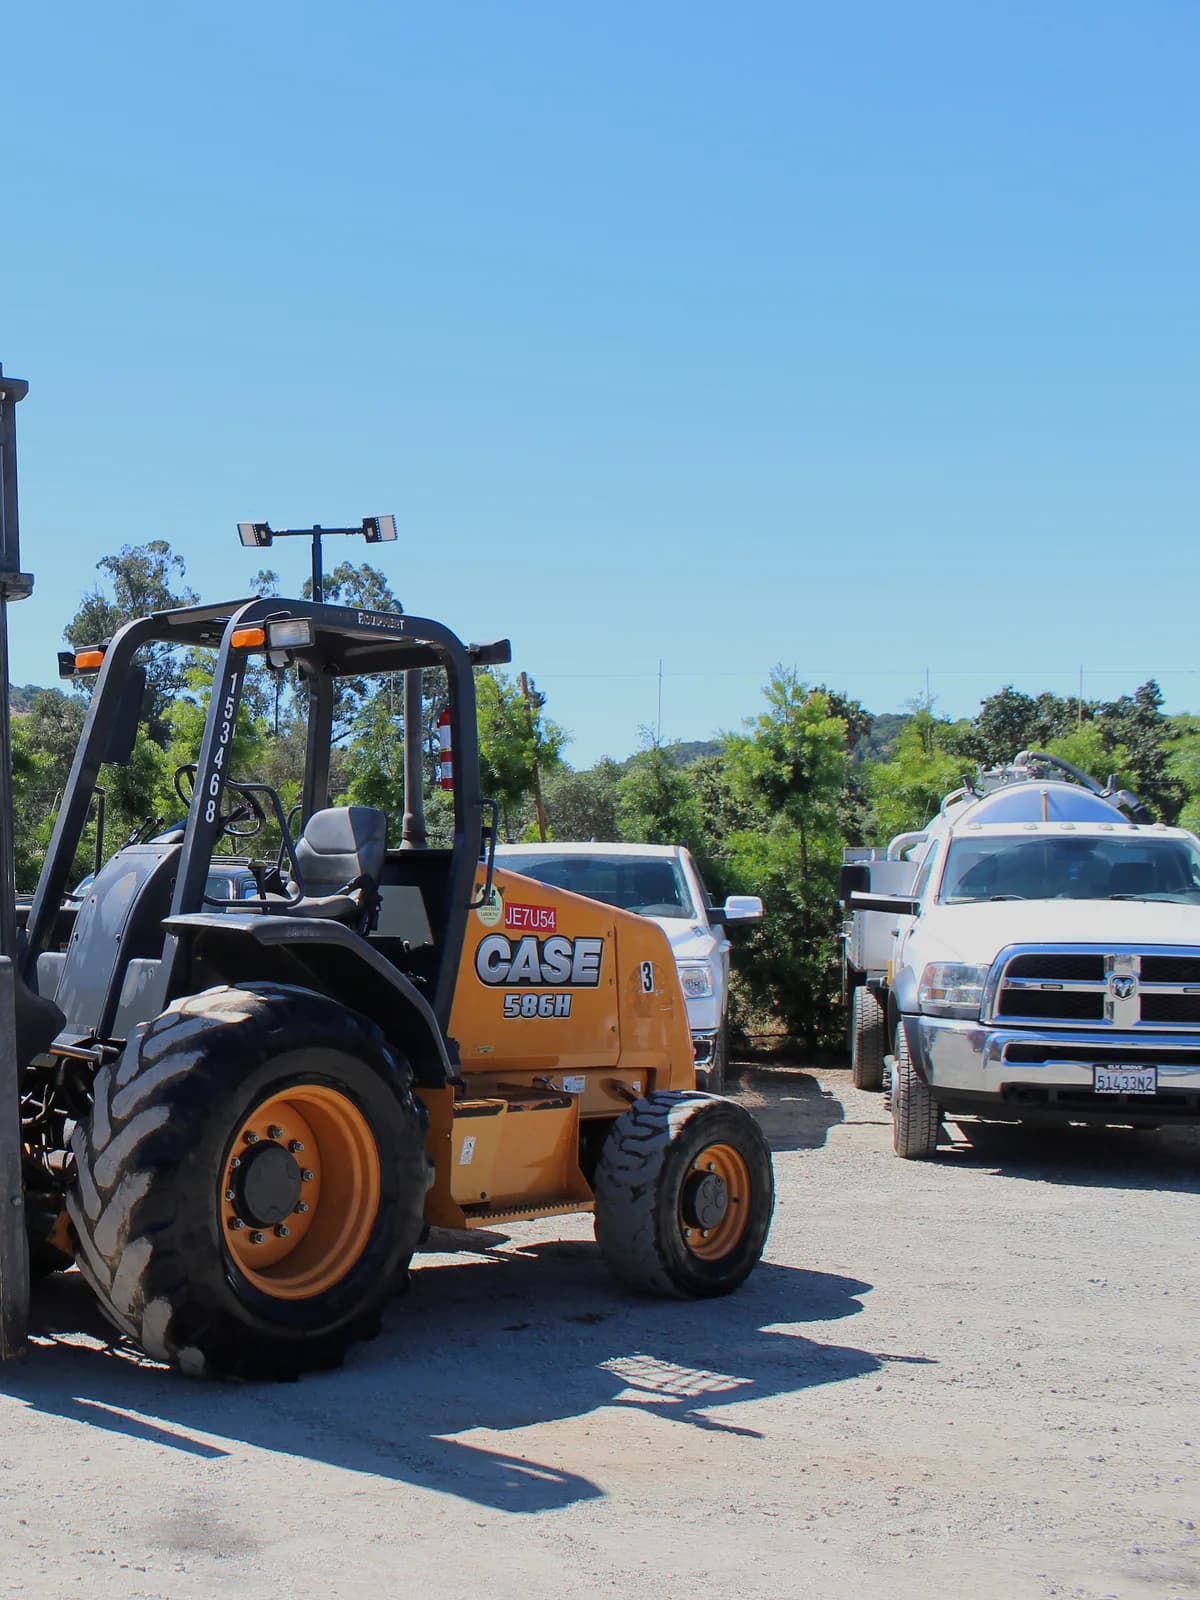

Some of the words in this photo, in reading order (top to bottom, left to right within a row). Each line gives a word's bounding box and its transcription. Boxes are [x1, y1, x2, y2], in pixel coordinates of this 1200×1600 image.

[205, 672, 238, 823] 153468
[505, 907, 556, 929] JE7U54
[476, 934, 604, 984] CASE
[642, 962, 653, 991] 3
[503, 994, 572, 1018] 586H
